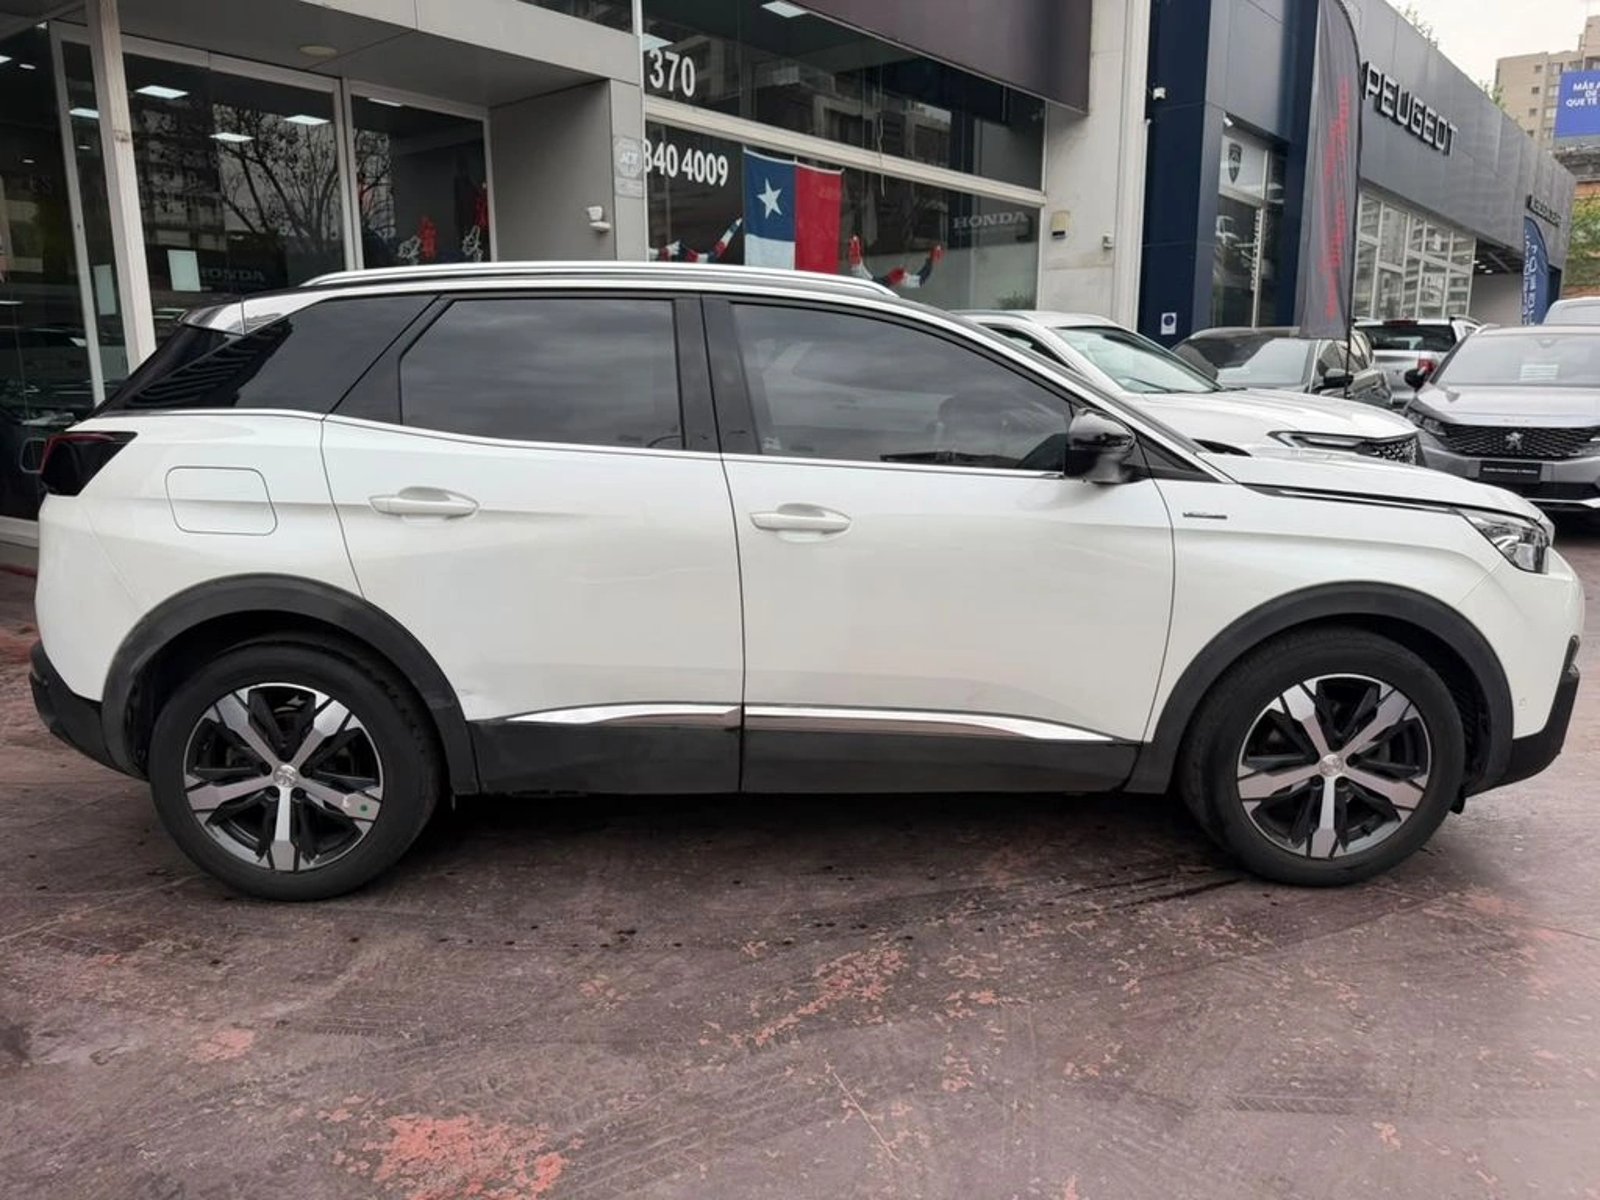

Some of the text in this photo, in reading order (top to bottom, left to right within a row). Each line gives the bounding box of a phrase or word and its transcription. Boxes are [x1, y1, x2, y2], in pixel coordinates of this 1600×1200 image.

[649, 48, 696, 97] 370
[1363, 61, 1458, 158] PEUGEOT
[1565, 98, 1585, 107] QUE
[681, 148, 729, 187] 4009
[953, 211, 1029, 229] HONDA
